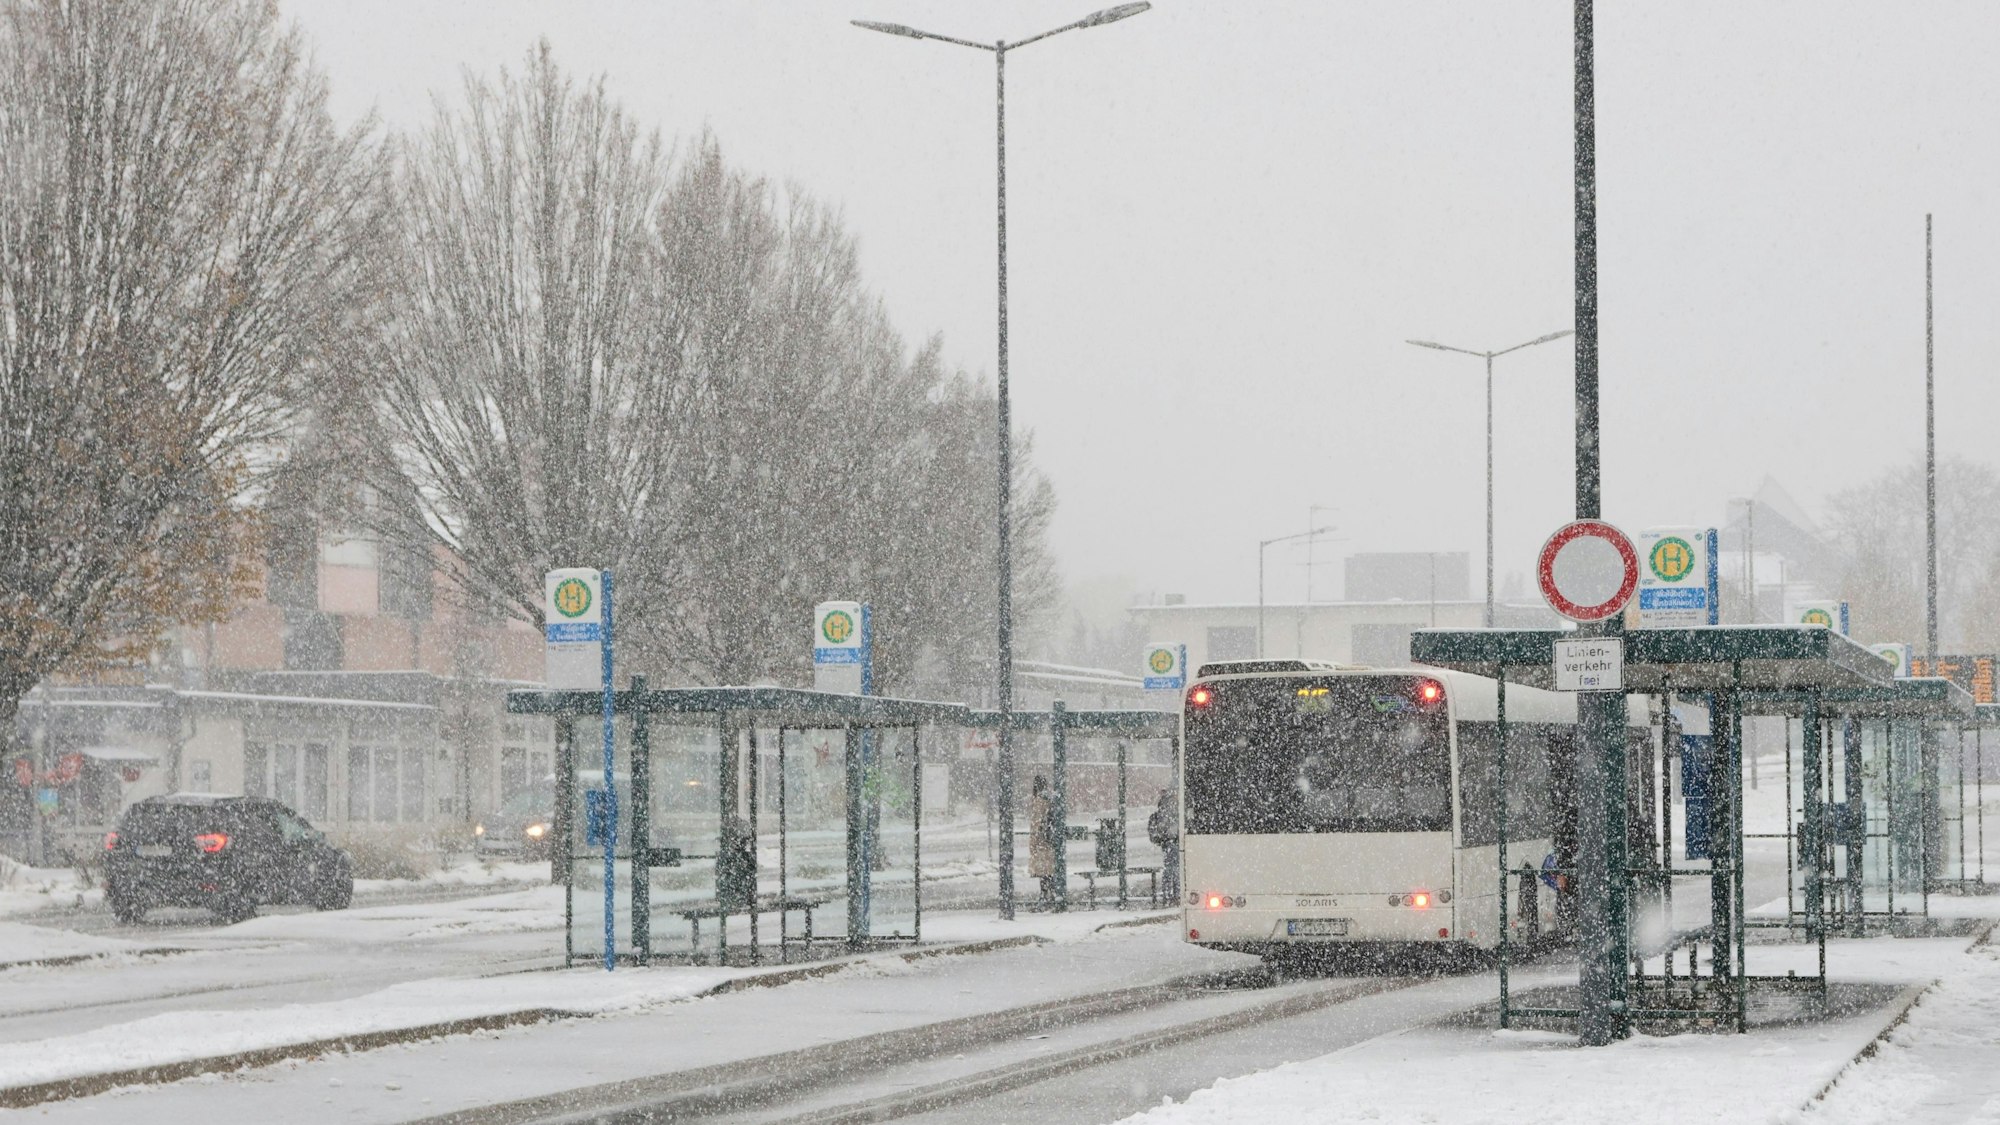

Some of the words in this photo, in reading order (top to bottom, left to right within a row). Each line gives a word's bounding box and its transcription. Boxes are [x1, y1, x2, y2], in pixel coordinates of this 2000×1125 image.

[1662, 547, 1681, 572] H
[565, 585, 580, 609] H
[831, 620, 844, 637] H
[1567, 645, 1610, 658] Linien-
[1565, 660, 1612, 672] verkehr
[1579, 674, 1600, 686] frei
[1295, 898, 1338, 907] SOLARIS
